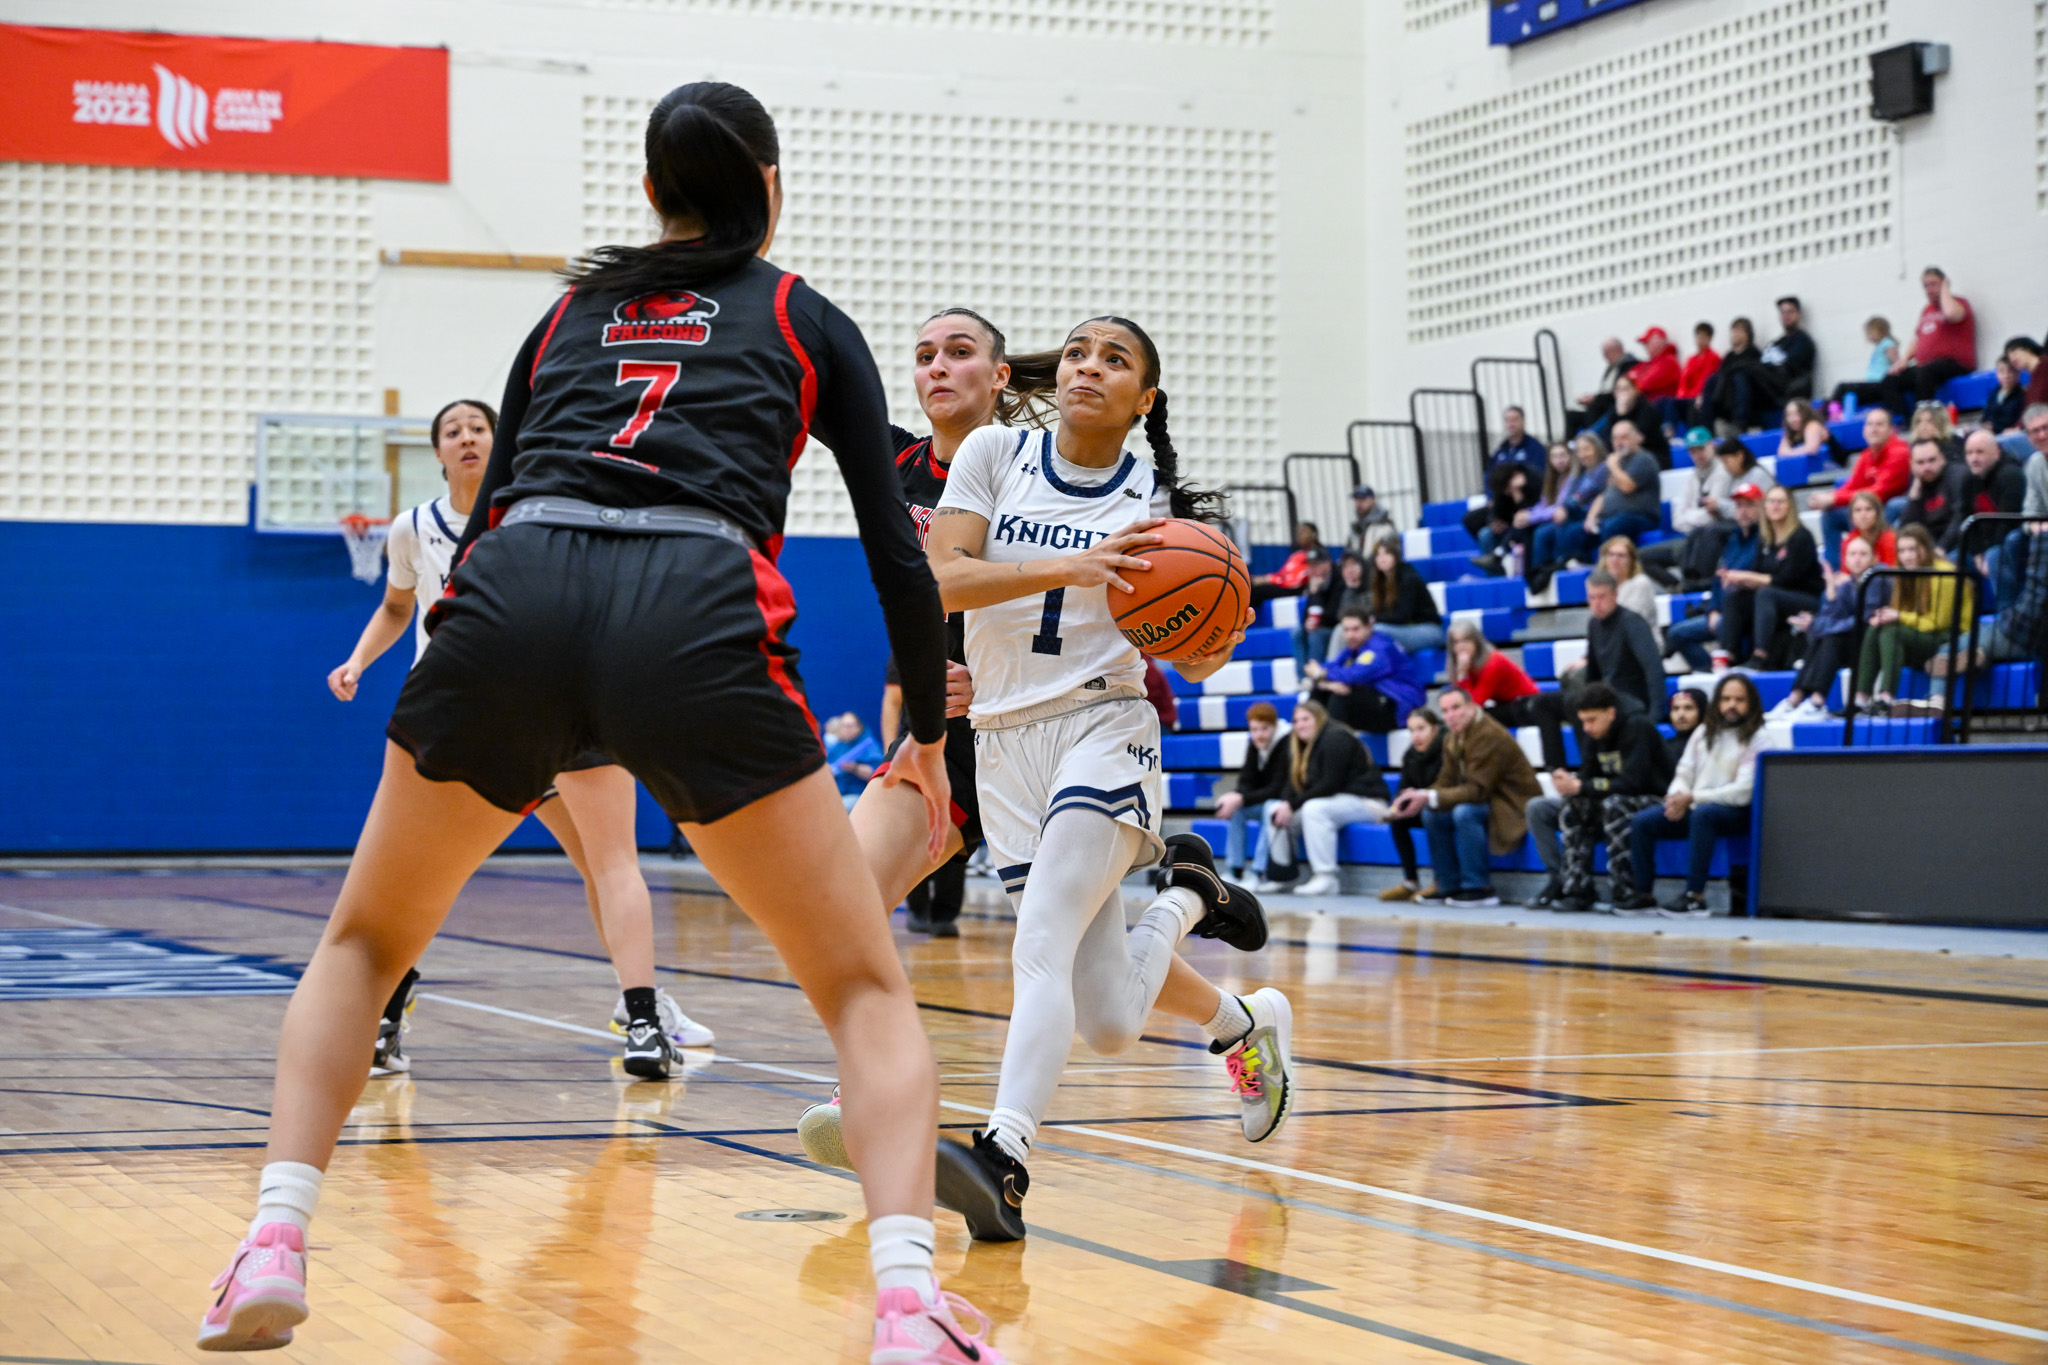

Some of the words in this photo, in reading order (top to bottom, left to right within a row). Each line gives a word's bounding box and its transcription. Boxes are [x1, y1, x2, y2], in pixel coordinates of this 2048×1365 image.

[73, 97, 150, 125] 2022
[606, 324, 706, 343] FALCONS
[610, 359, 681, 448] 7
[1031, 586, 1064, 656] 1
[1120, 602, 1201, 649] Wilson
